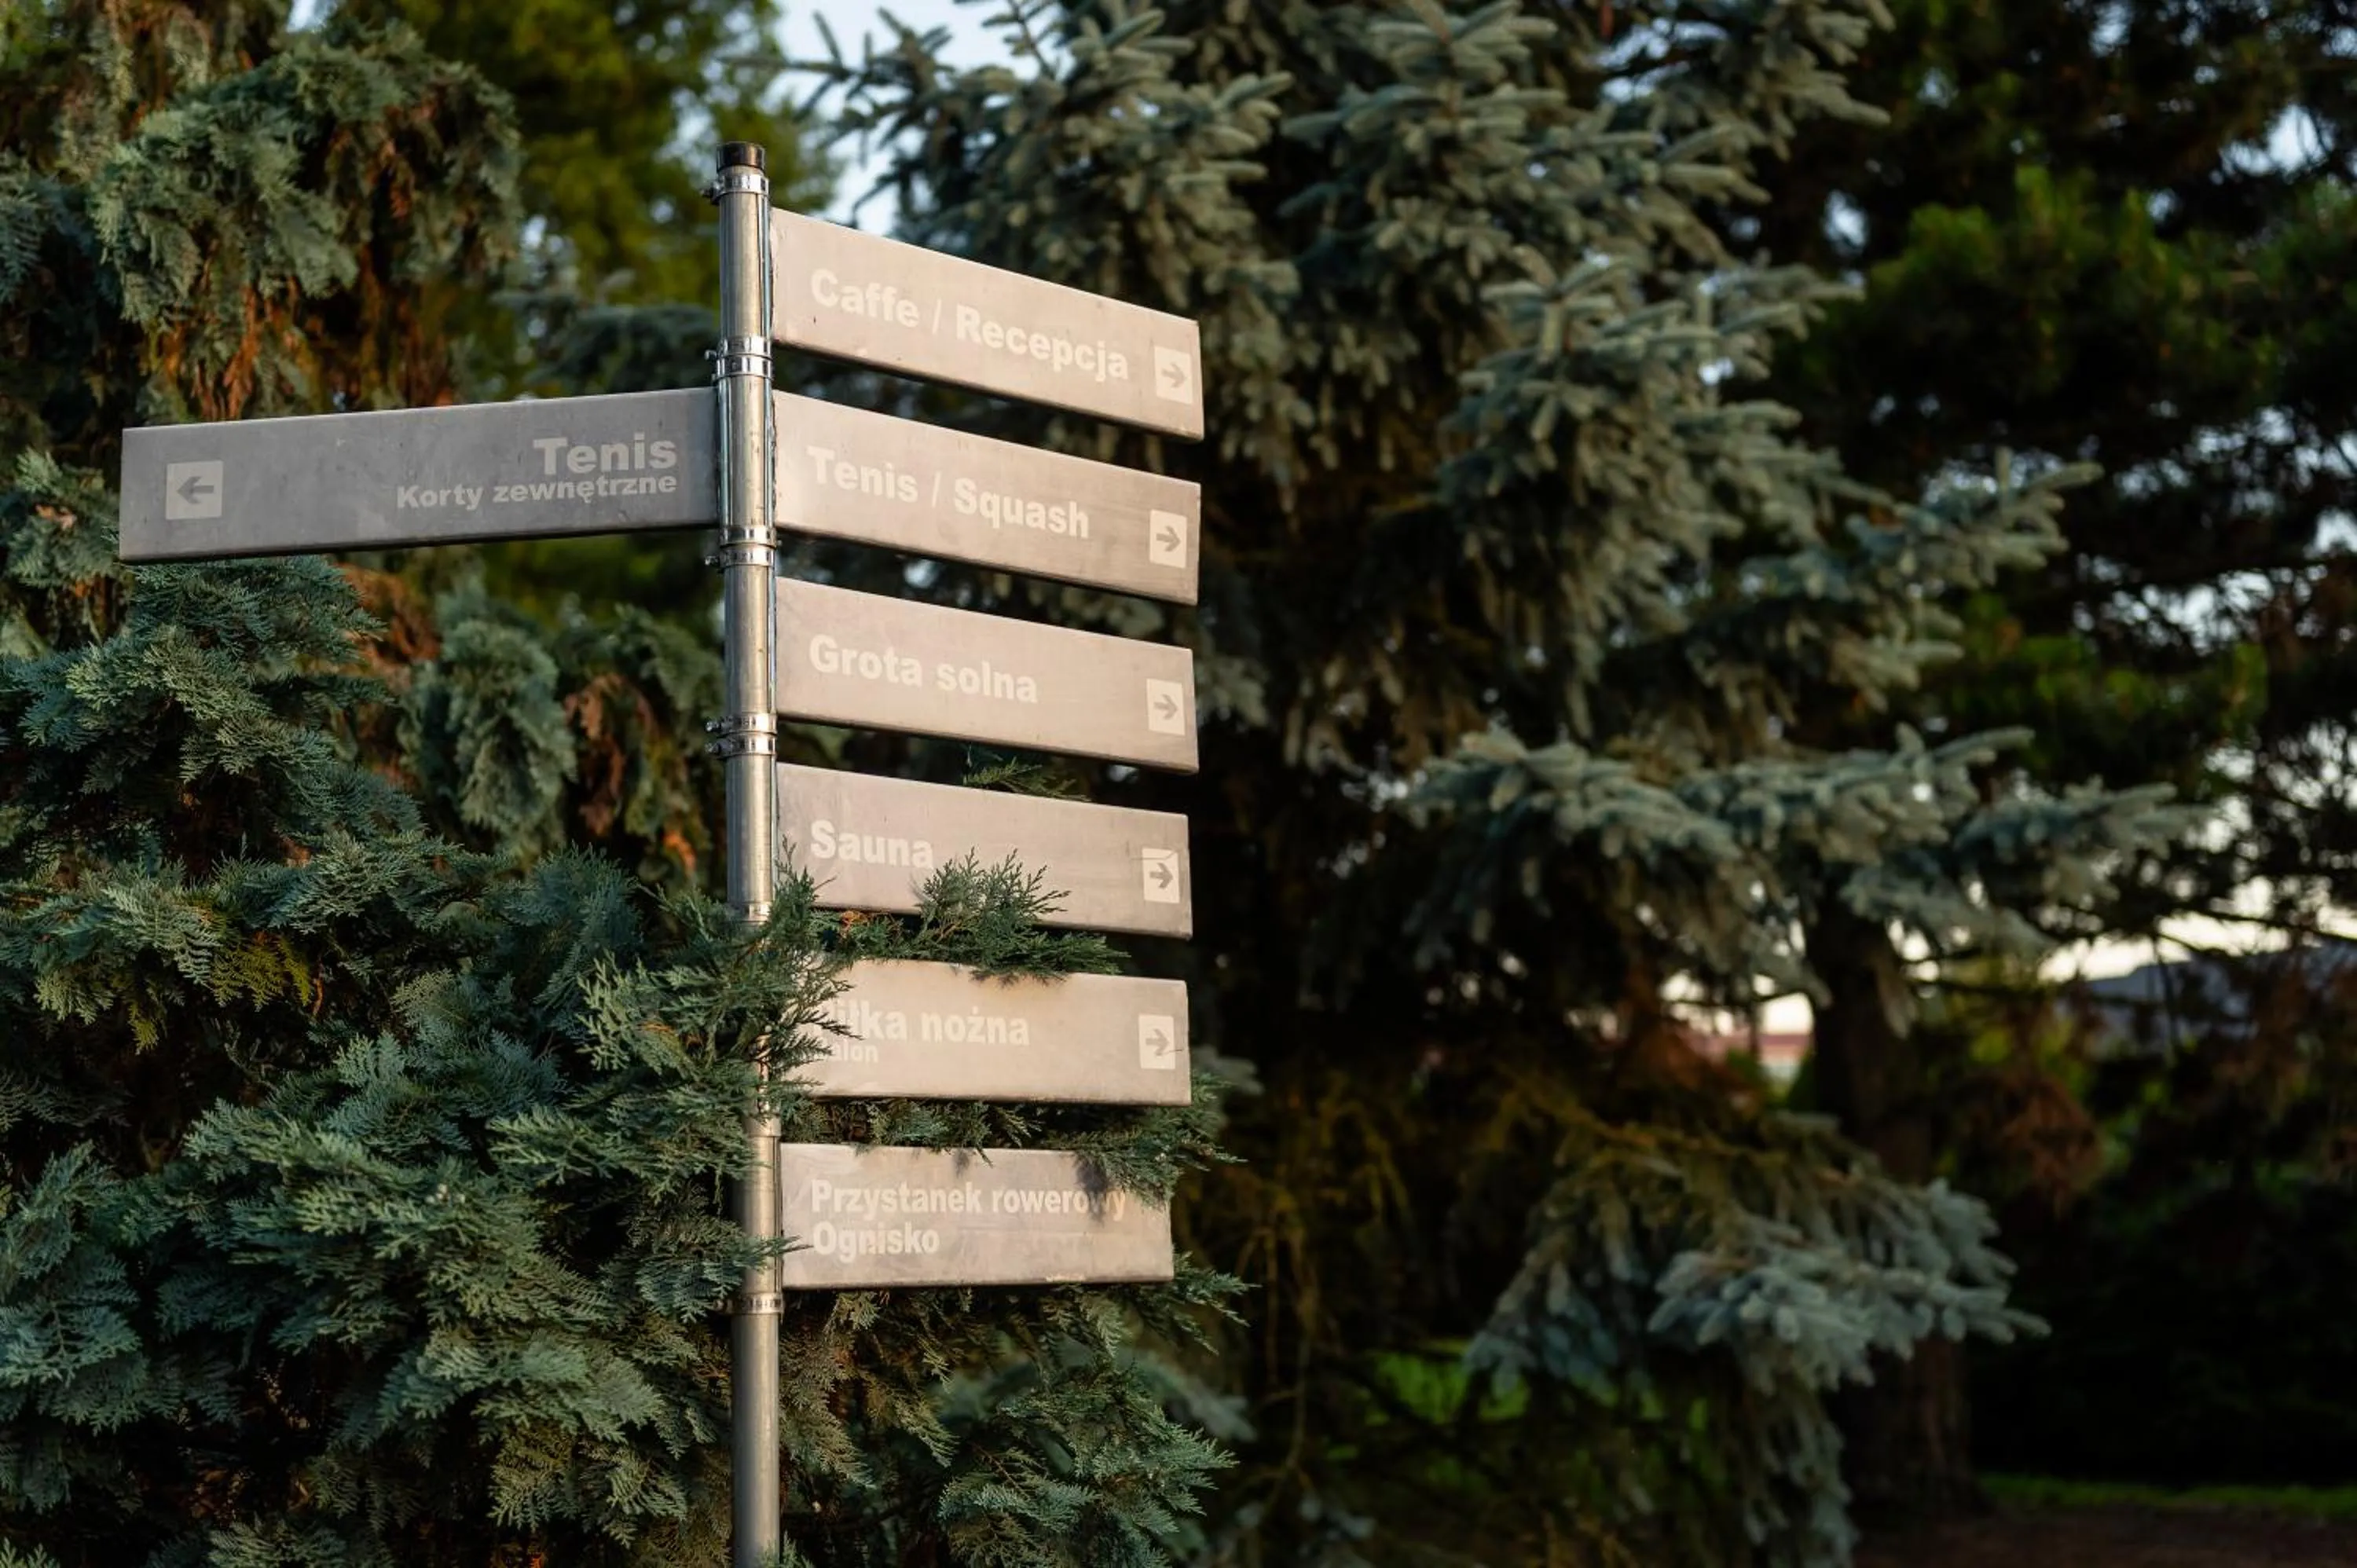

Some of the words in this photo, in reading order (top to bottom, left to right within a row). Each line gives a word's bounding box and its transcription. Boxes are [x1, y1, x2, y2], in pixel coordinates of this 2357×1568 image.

[811, 268, 919, 328] Caffe
[932, 298, 943, 335] /
[955, 303, 1129, 382] Recepcja
[533, 433, 677, 475] Tenis
[398, 484, 484, 511] Korty
[493, 475, 676, 503] zewnętrzne
[806, 445, 918, 503] Tenis
[932, 471, 943, 507] /
[954, 478, 1090, 539] Squash
[809, 634, 923, 688] Grota
[937, 660, 1038, 703] solna
[810, 819, 933, 870] Sauna
[921, 1006, 1030, 1046] nożna
[814, 1039, 878, 1062] alon
[811, 1179, 982, 1220] Przystanek
[992, 1189, 1126, 1222] rowerowy
[812, 1221, 940, 1263] Ognisko
